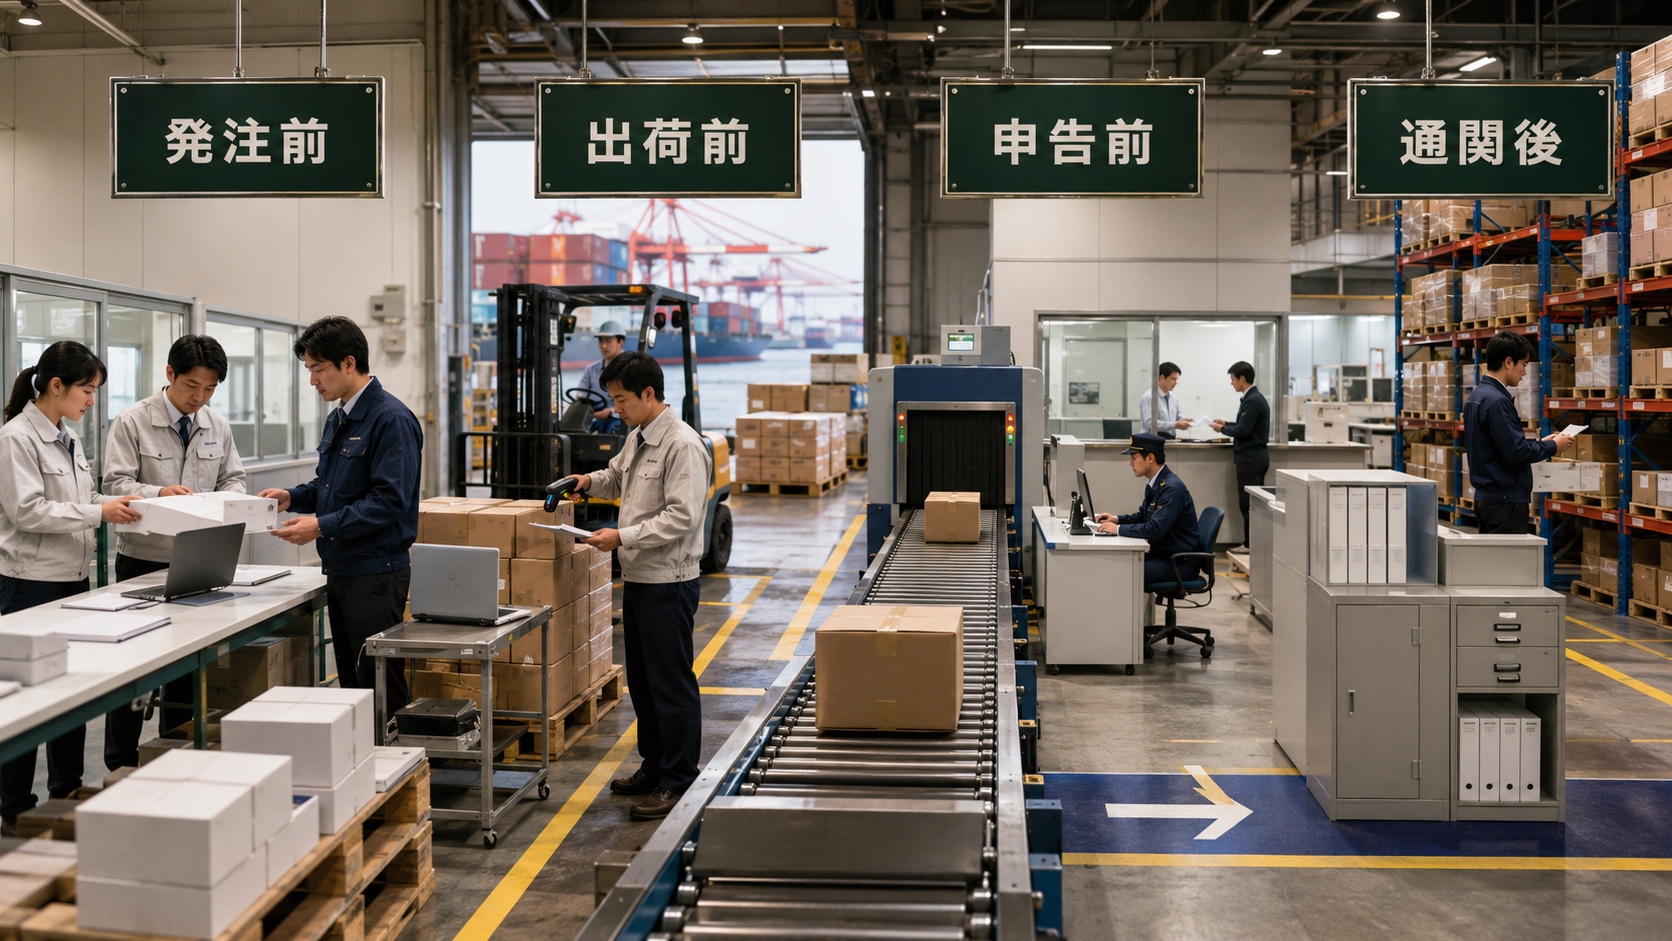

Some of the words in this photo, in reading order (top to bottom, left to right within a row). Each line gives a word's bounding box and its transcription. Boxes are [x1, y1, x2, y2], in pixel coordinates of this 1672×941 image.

[165, 117, 328, 164] 発注前
[588, 118, 749, 164] 出荷前
[995, 117, 1153, 165] 申告前
[1399, 118, 1563, 165] 通関後
